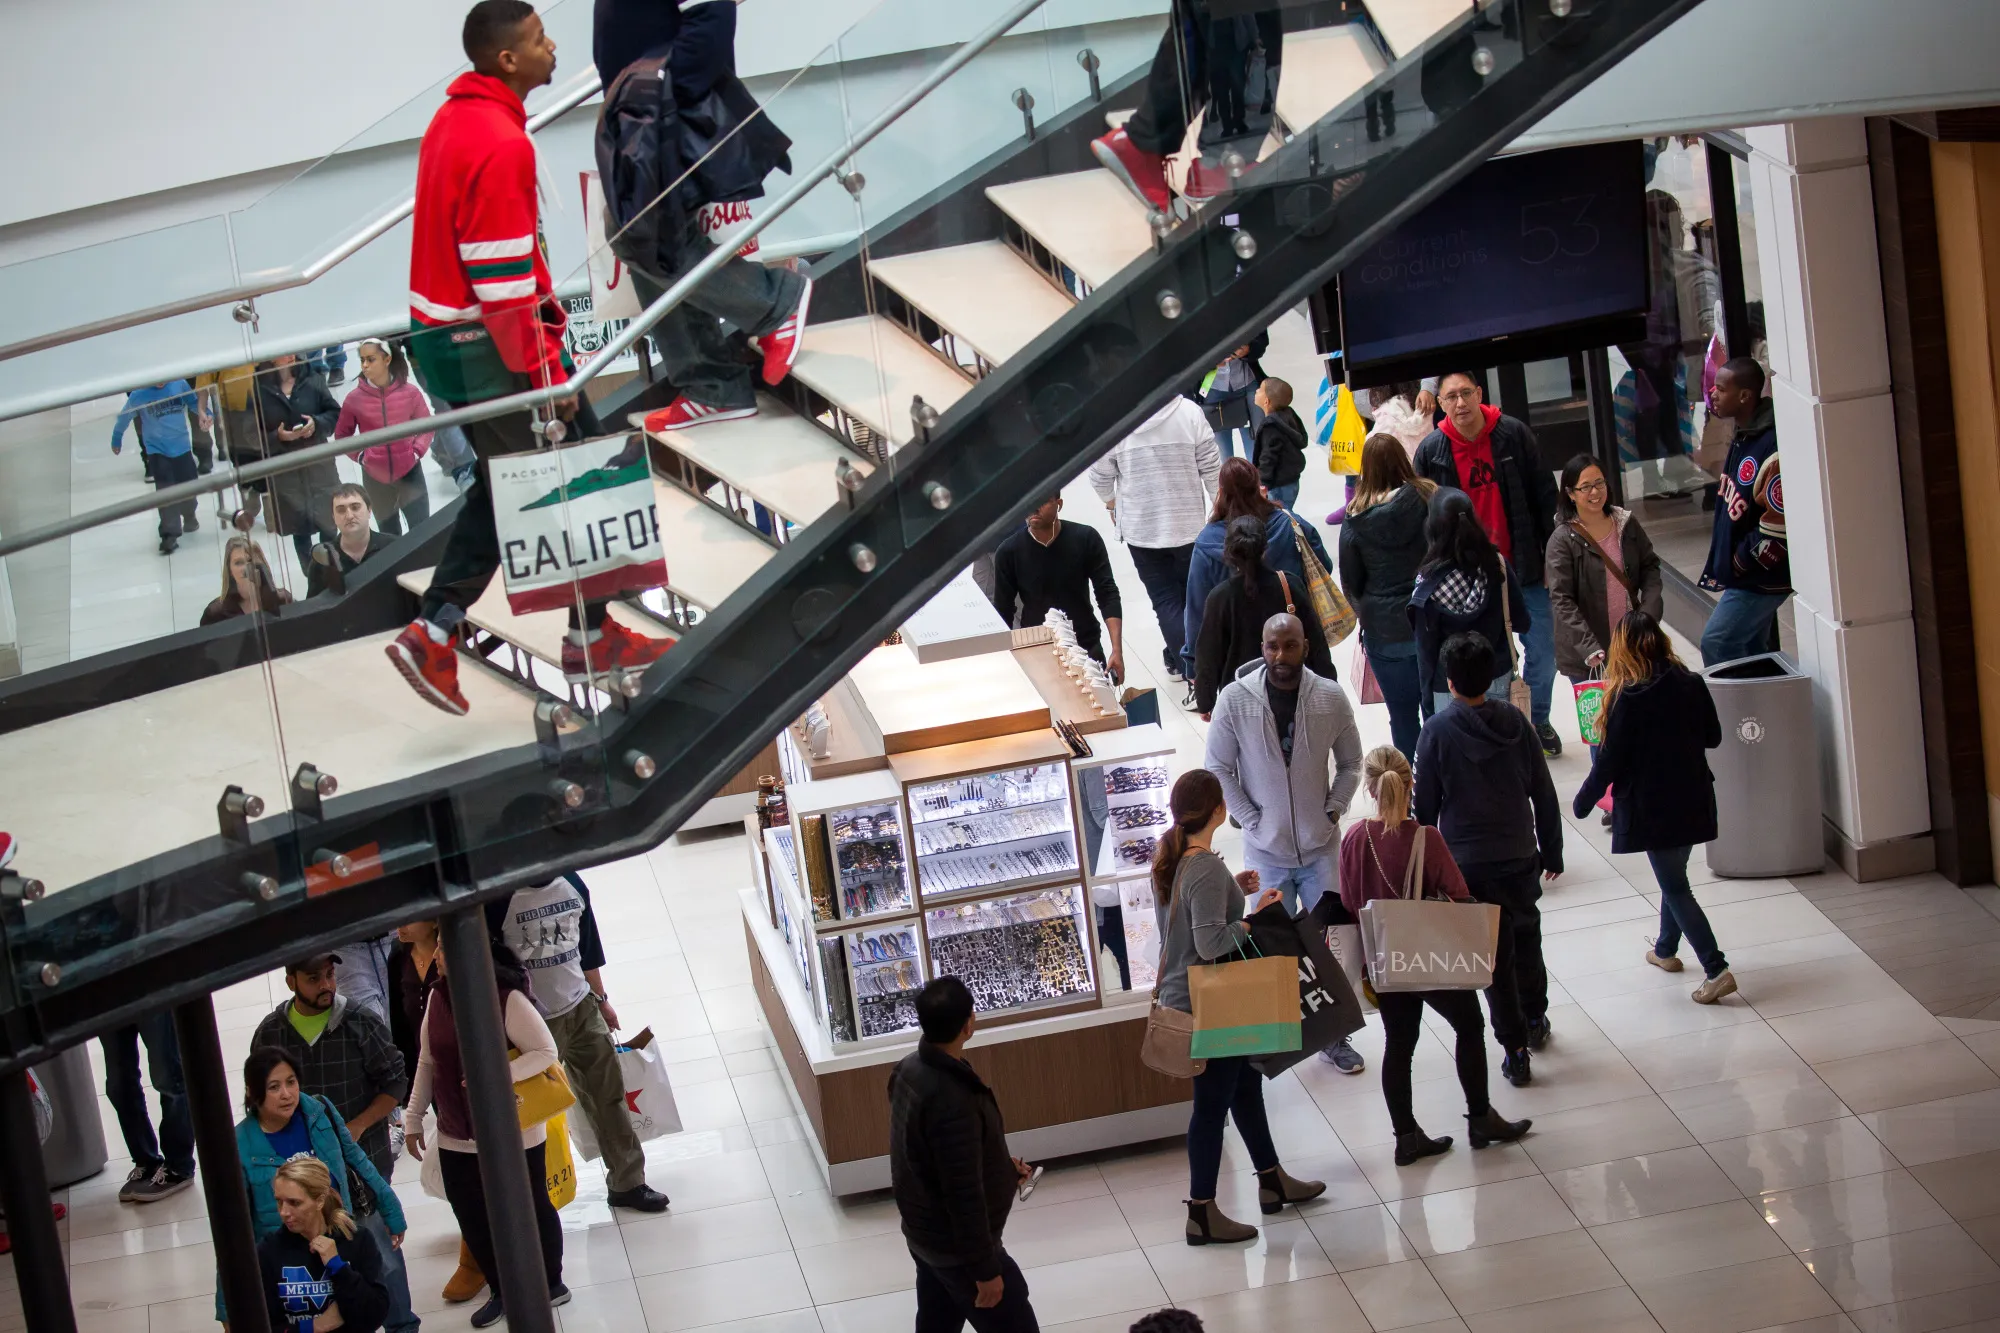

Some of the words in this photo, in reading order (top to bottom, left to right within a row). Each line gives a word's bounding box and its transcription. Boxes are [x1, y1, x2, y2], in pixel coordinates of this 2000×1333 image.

[1519, 192, 1601, 265] 53
[1378, 226, 1471, 262] Current
[1360, 247, 1489, 284] Conditions
[570, 296, 592, 313] RIG
[517, 910, 538, 922] THE
[539, 899, 580, 917] BEATLES
[1330, 926, 1342, 965] NOR
[528, 955, 565, 969] ABBEY
[1391, 951, 1492, 973] BANAN
[561, 1165, 572, 1182] 21
